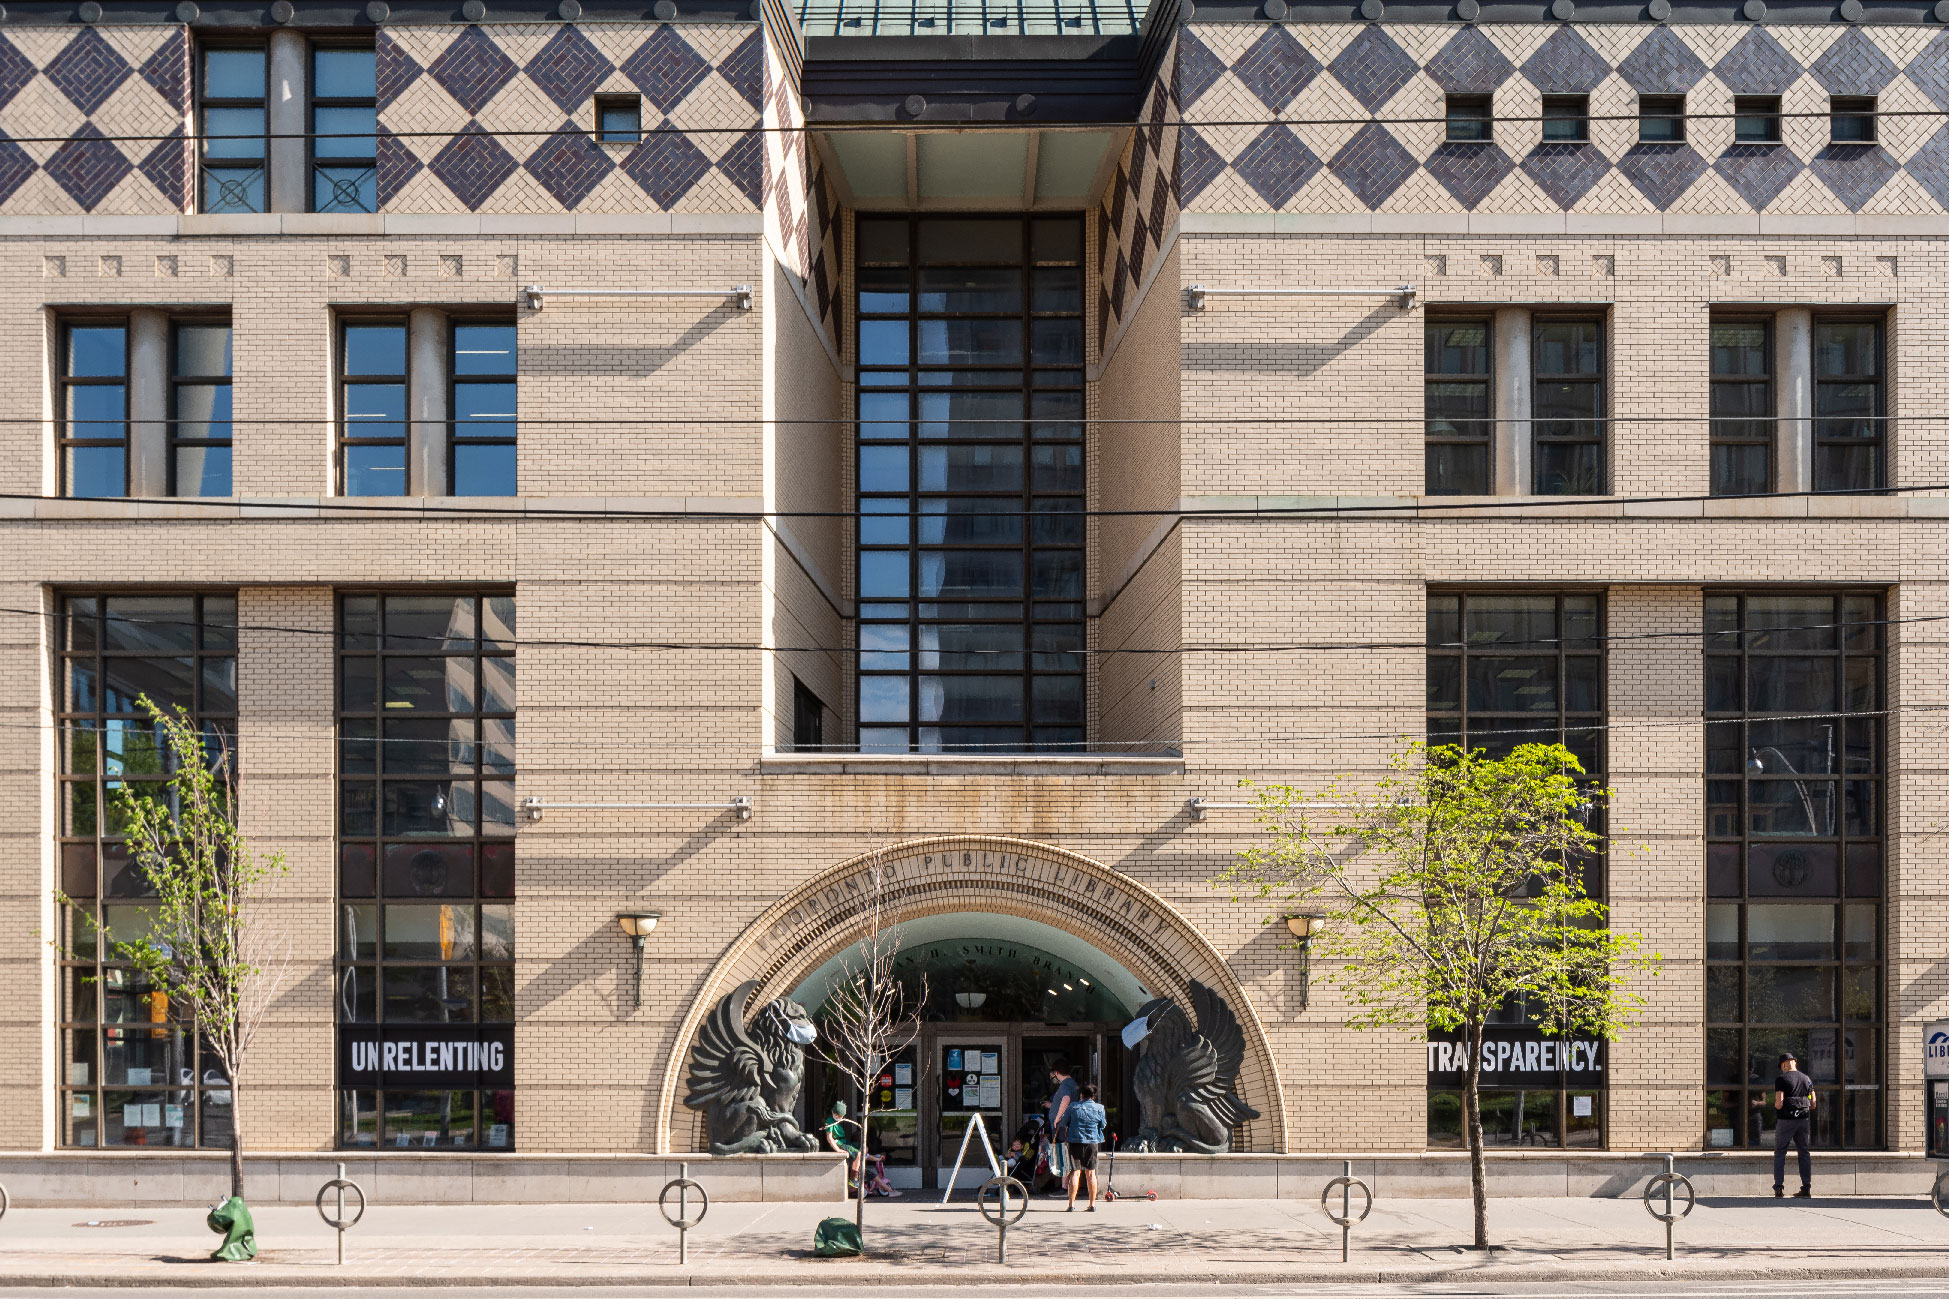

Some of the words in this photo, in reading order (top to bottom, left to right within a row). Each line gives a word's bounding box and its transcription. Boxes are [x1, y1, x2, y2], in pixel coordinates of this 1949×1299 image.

[773, 864, 897, 936] TORONTO
[924, 852, 1029, 873] PUBLIC
[1054, 864, 1170, 935] LIBRARY
[962, 945, 1017, 959] SMITH
[351, 1041, 504, 1072] UNRELENTING
[1928, 1045, 1949, 1058] LIB
